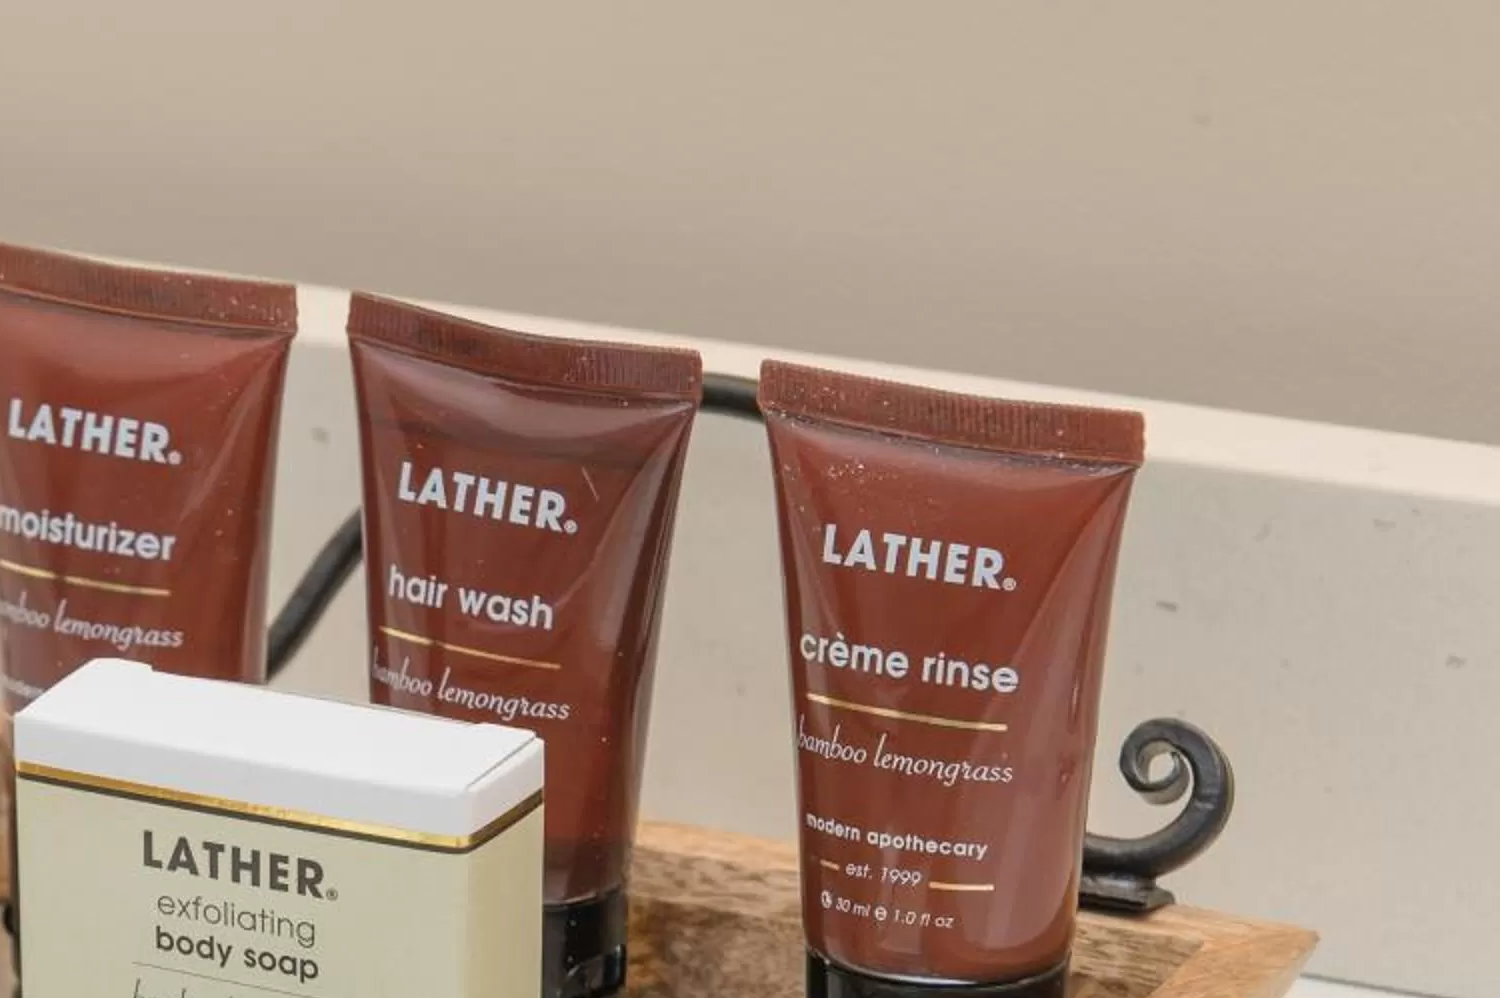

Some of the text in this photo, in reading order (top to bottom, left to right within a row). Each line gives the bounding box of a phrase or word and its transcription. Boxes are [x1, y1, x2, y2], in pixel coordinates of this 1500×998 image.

[54, 598, 185, 652] lemongrass
[388, 563, 553, 630] hair wash
[372, 645, 571, 721] bamboo lemongrass
[800, 631, 1019, 693] crème rinse
[798, 713, 1013, 787] bamboo lemongrass
[806, 812, 989, 861] modern apothecary
[880, 866, 922, 887] 1999
[156, 894, 315, 949] exfoliating
[934, 916, 955, 929] oz
[155, 925, 319, 984] body soap
